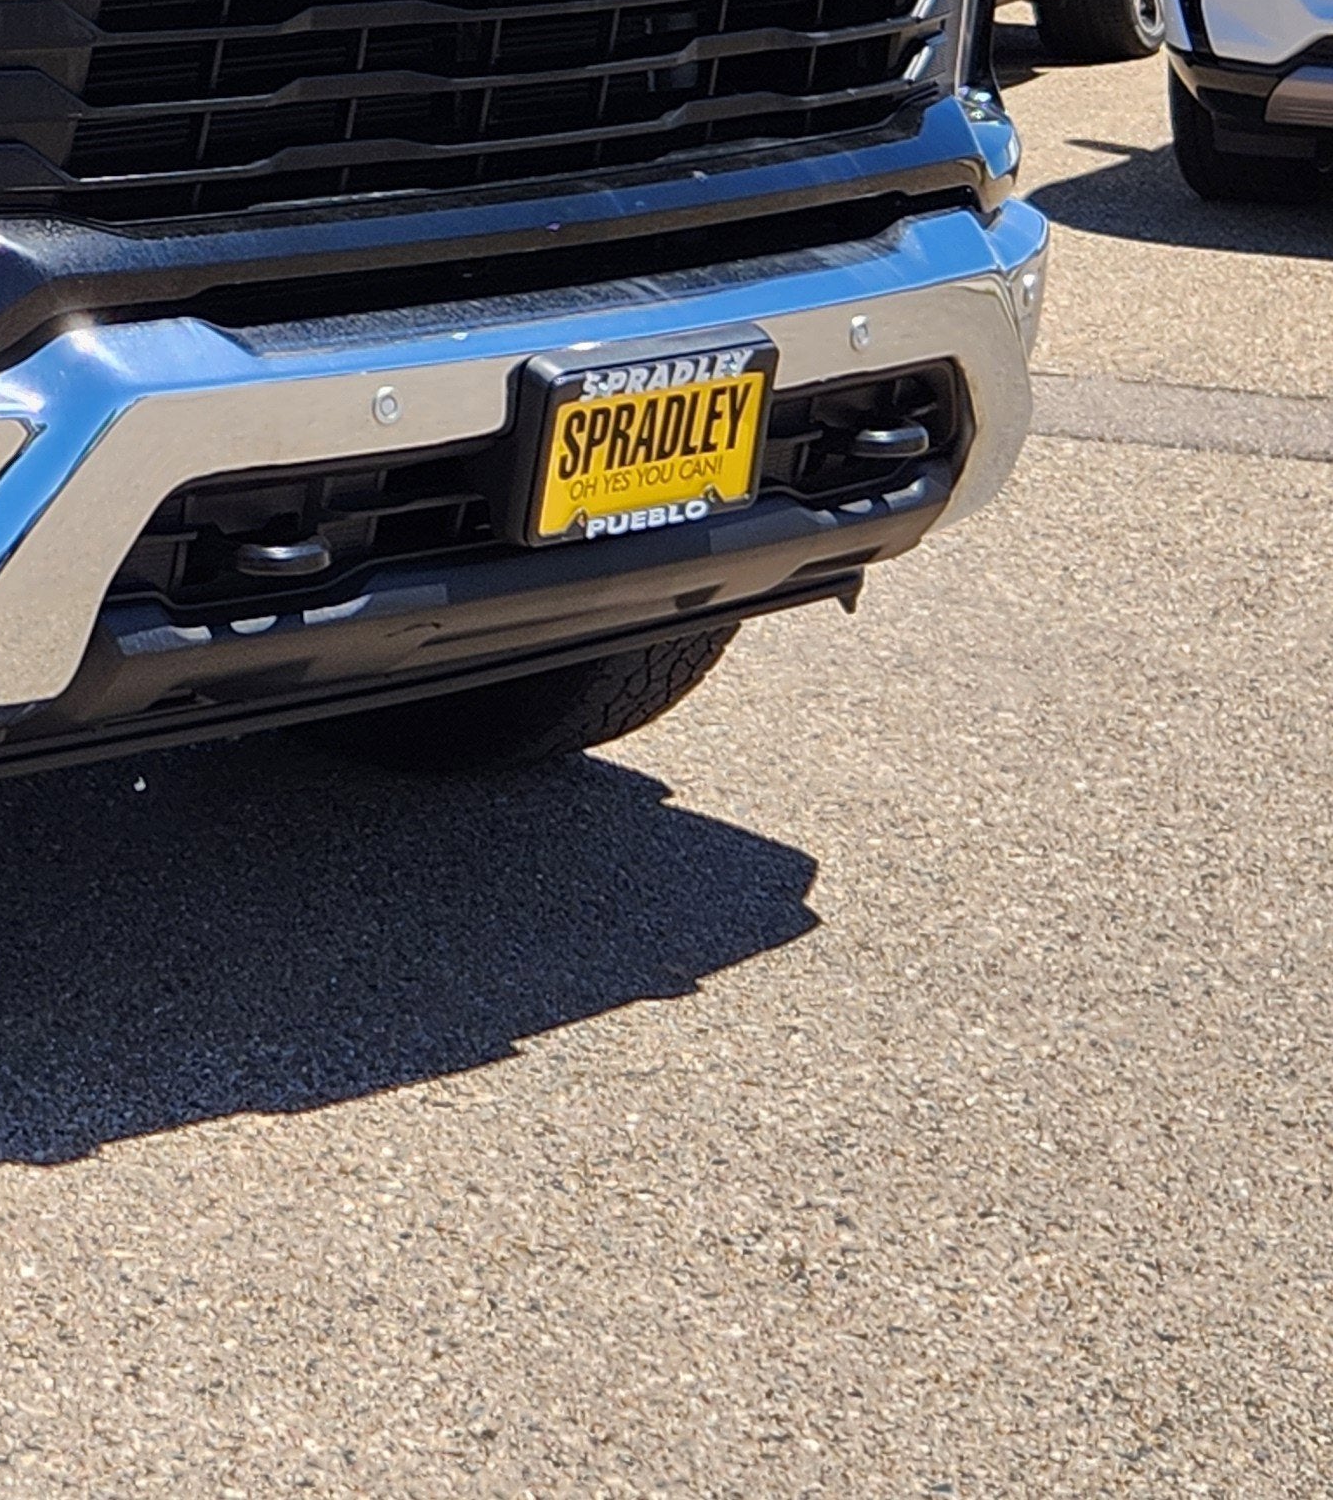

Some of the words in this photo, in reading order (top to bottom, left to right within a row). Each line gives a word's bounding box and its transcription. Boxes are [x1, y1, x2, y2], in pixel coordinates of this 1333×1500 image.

[580, 349, 754, 401] SPRADLEY
[558, 382, 753, 481] SPRADLEY
[570, 475, 598, 501] OH
[603, 468, 630, 494] YES
[638, 461, 674, 486] YOU
[678, 455, 723, 480] CAN!
[585, 500, 709, 540] PUEBLO
